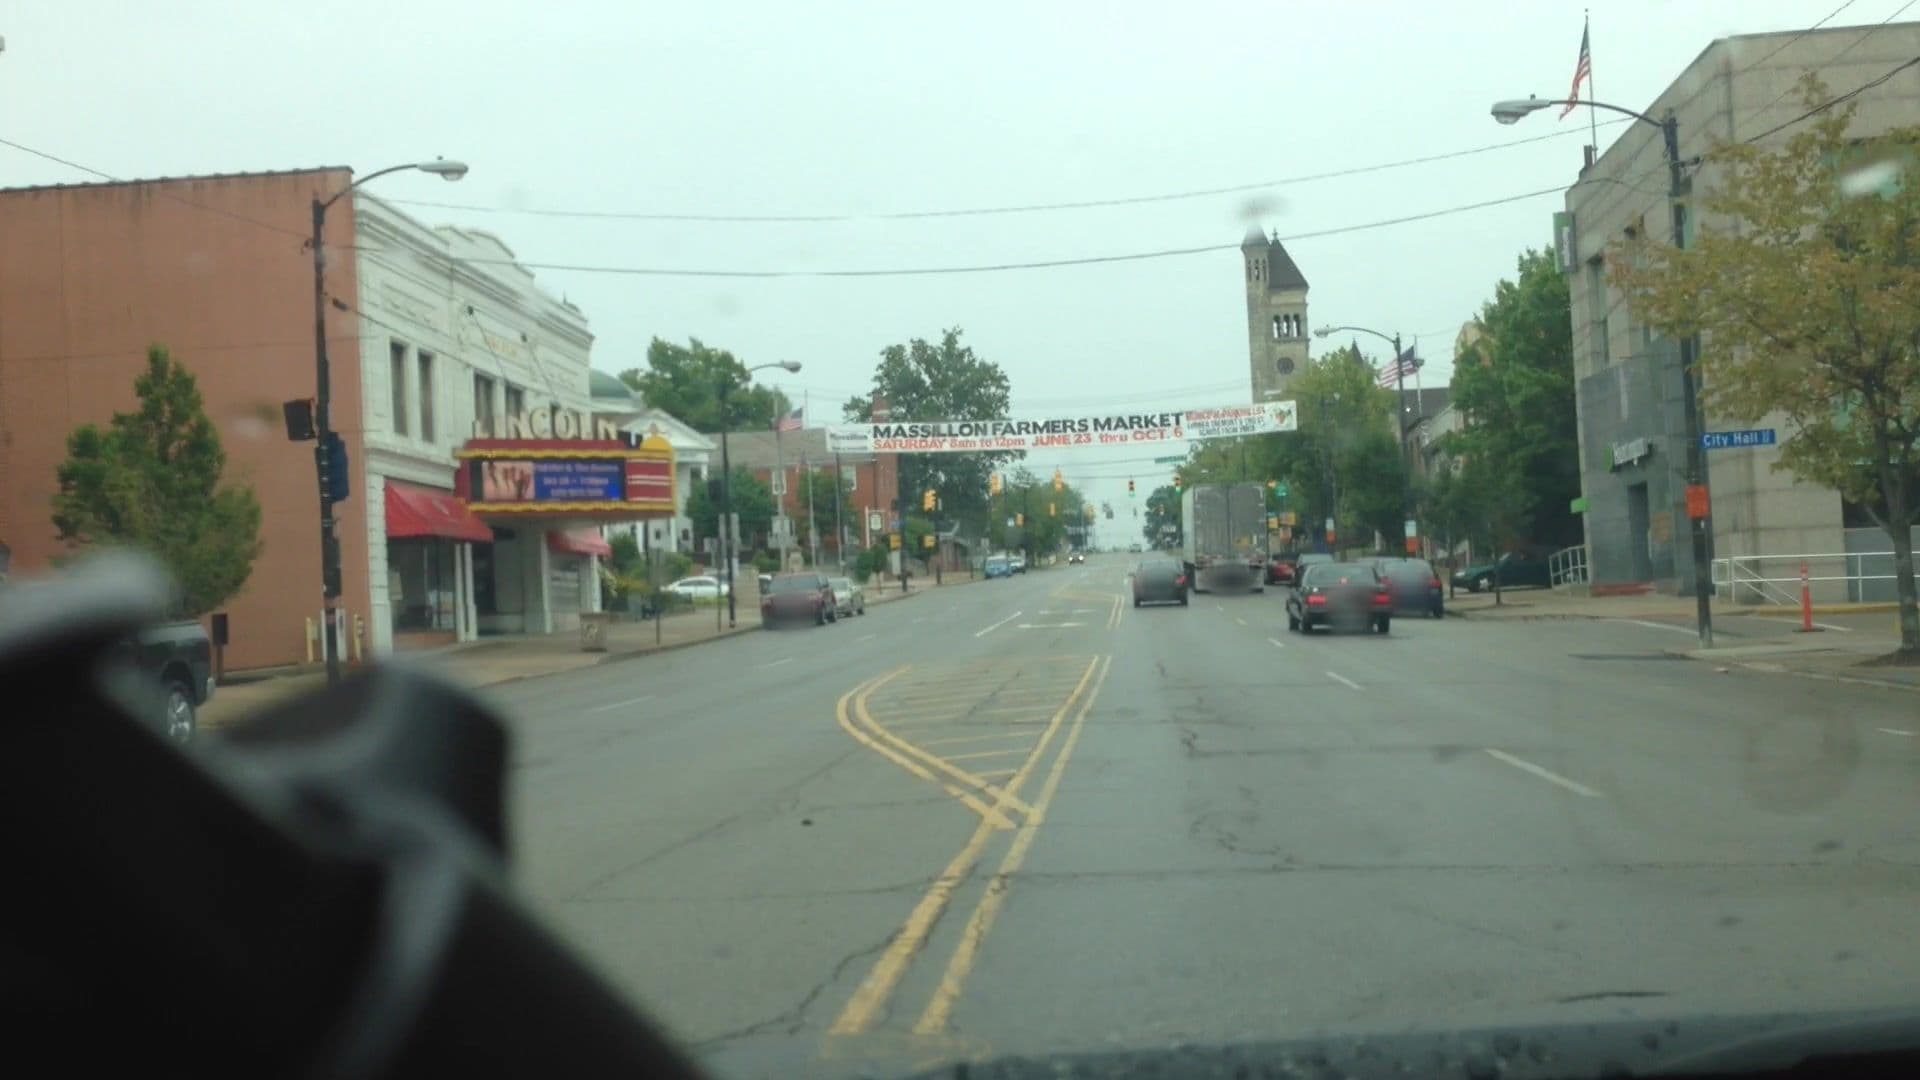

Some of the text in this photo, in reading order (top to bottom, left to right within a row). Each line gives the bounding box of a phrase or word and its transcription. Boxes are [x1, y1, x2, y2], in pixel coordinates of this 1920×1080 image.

[472, 408, 618, 440] LINCOLN
[872, 423, 987, 438] MASSILLON
[992, 420, 1088, 436] FARMERS
[1093, 413, 1184, 431] MARKET
[873, 438, 944, 449] SATURDAY
[950, 438, 977, 449] 8am
[980, 438, 992, 448] to
[996, 436, 1025, 448] 12pm
[1032, 433, 1071, 447] JUNE
[1073, 432, 1091, 444] 23
[1099, 431, 1128, 443] thru
[1173, 426, 1183, 438] 6
[1703, 433, 1728, 449] City
[1733, 430, 1759, 445] Hall
